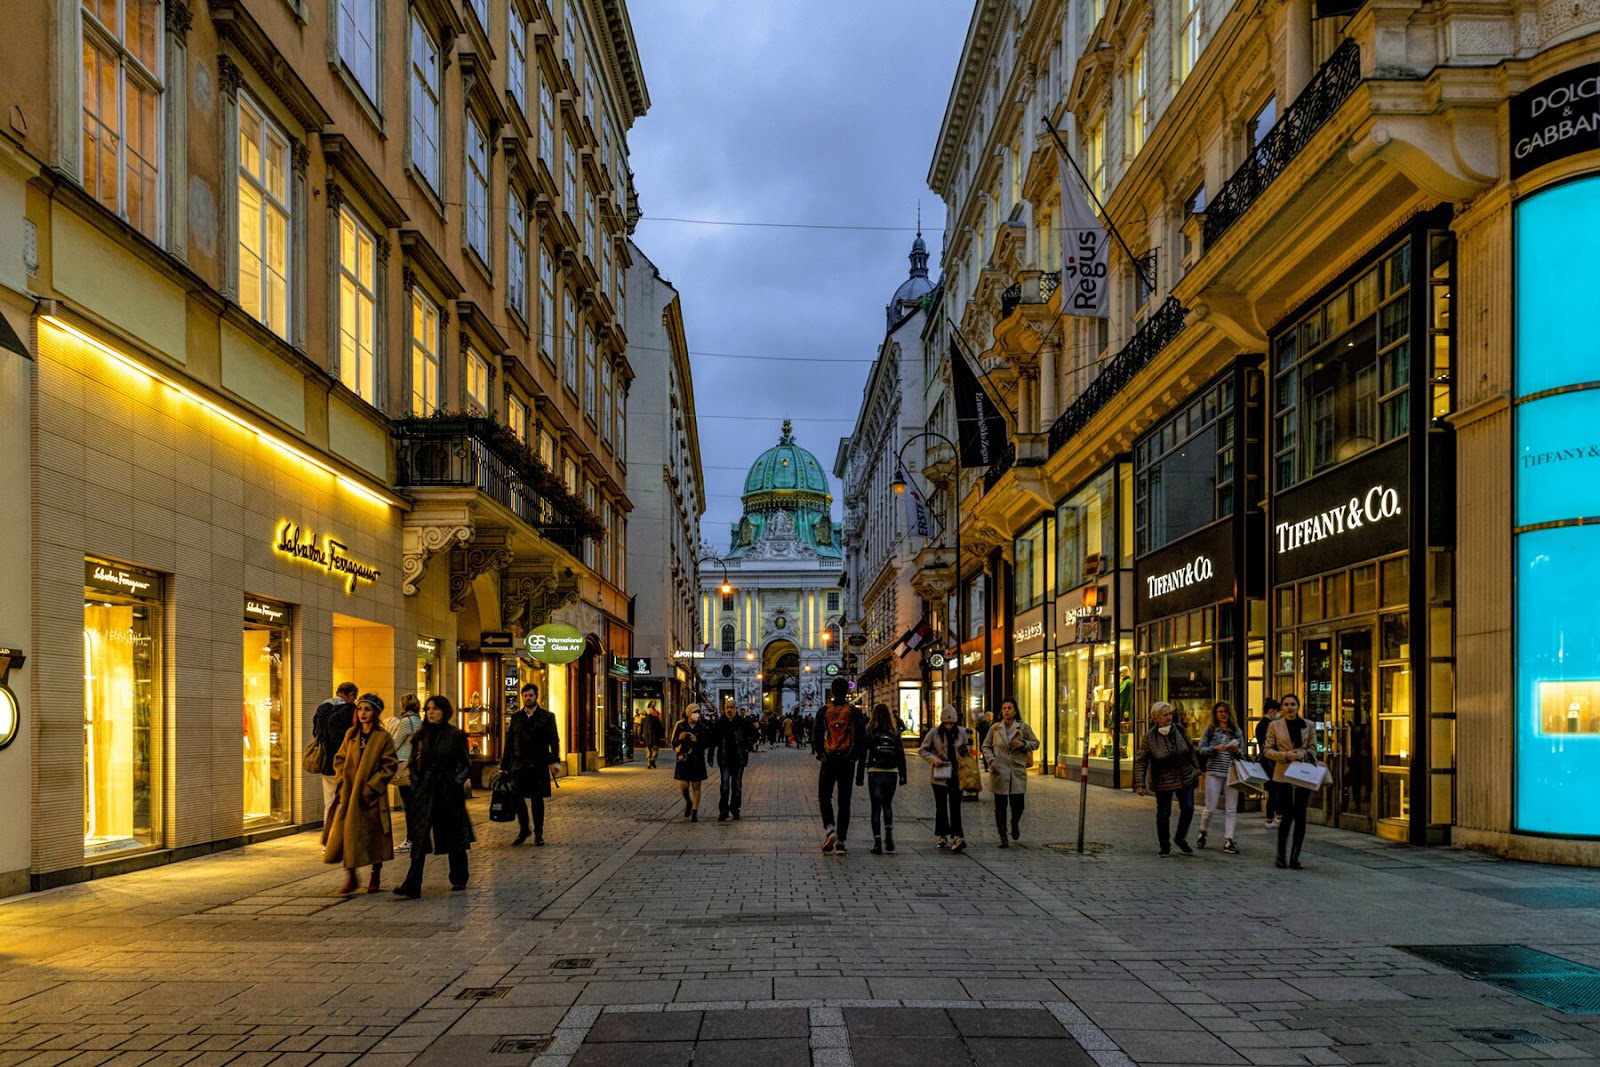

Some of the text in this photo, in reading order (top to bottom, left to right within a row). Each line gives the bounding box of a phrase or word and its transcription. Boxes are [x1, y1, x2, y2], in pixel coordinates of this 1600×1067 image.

[1562, 106, 1573, 117] &
[1074, 230, 1107, 309] Regus
[980, 440, 990, 464] Zegna
[278, 522, 381, 592] Salvatore Ferragamo
[528, 634, 546, 647] GS
